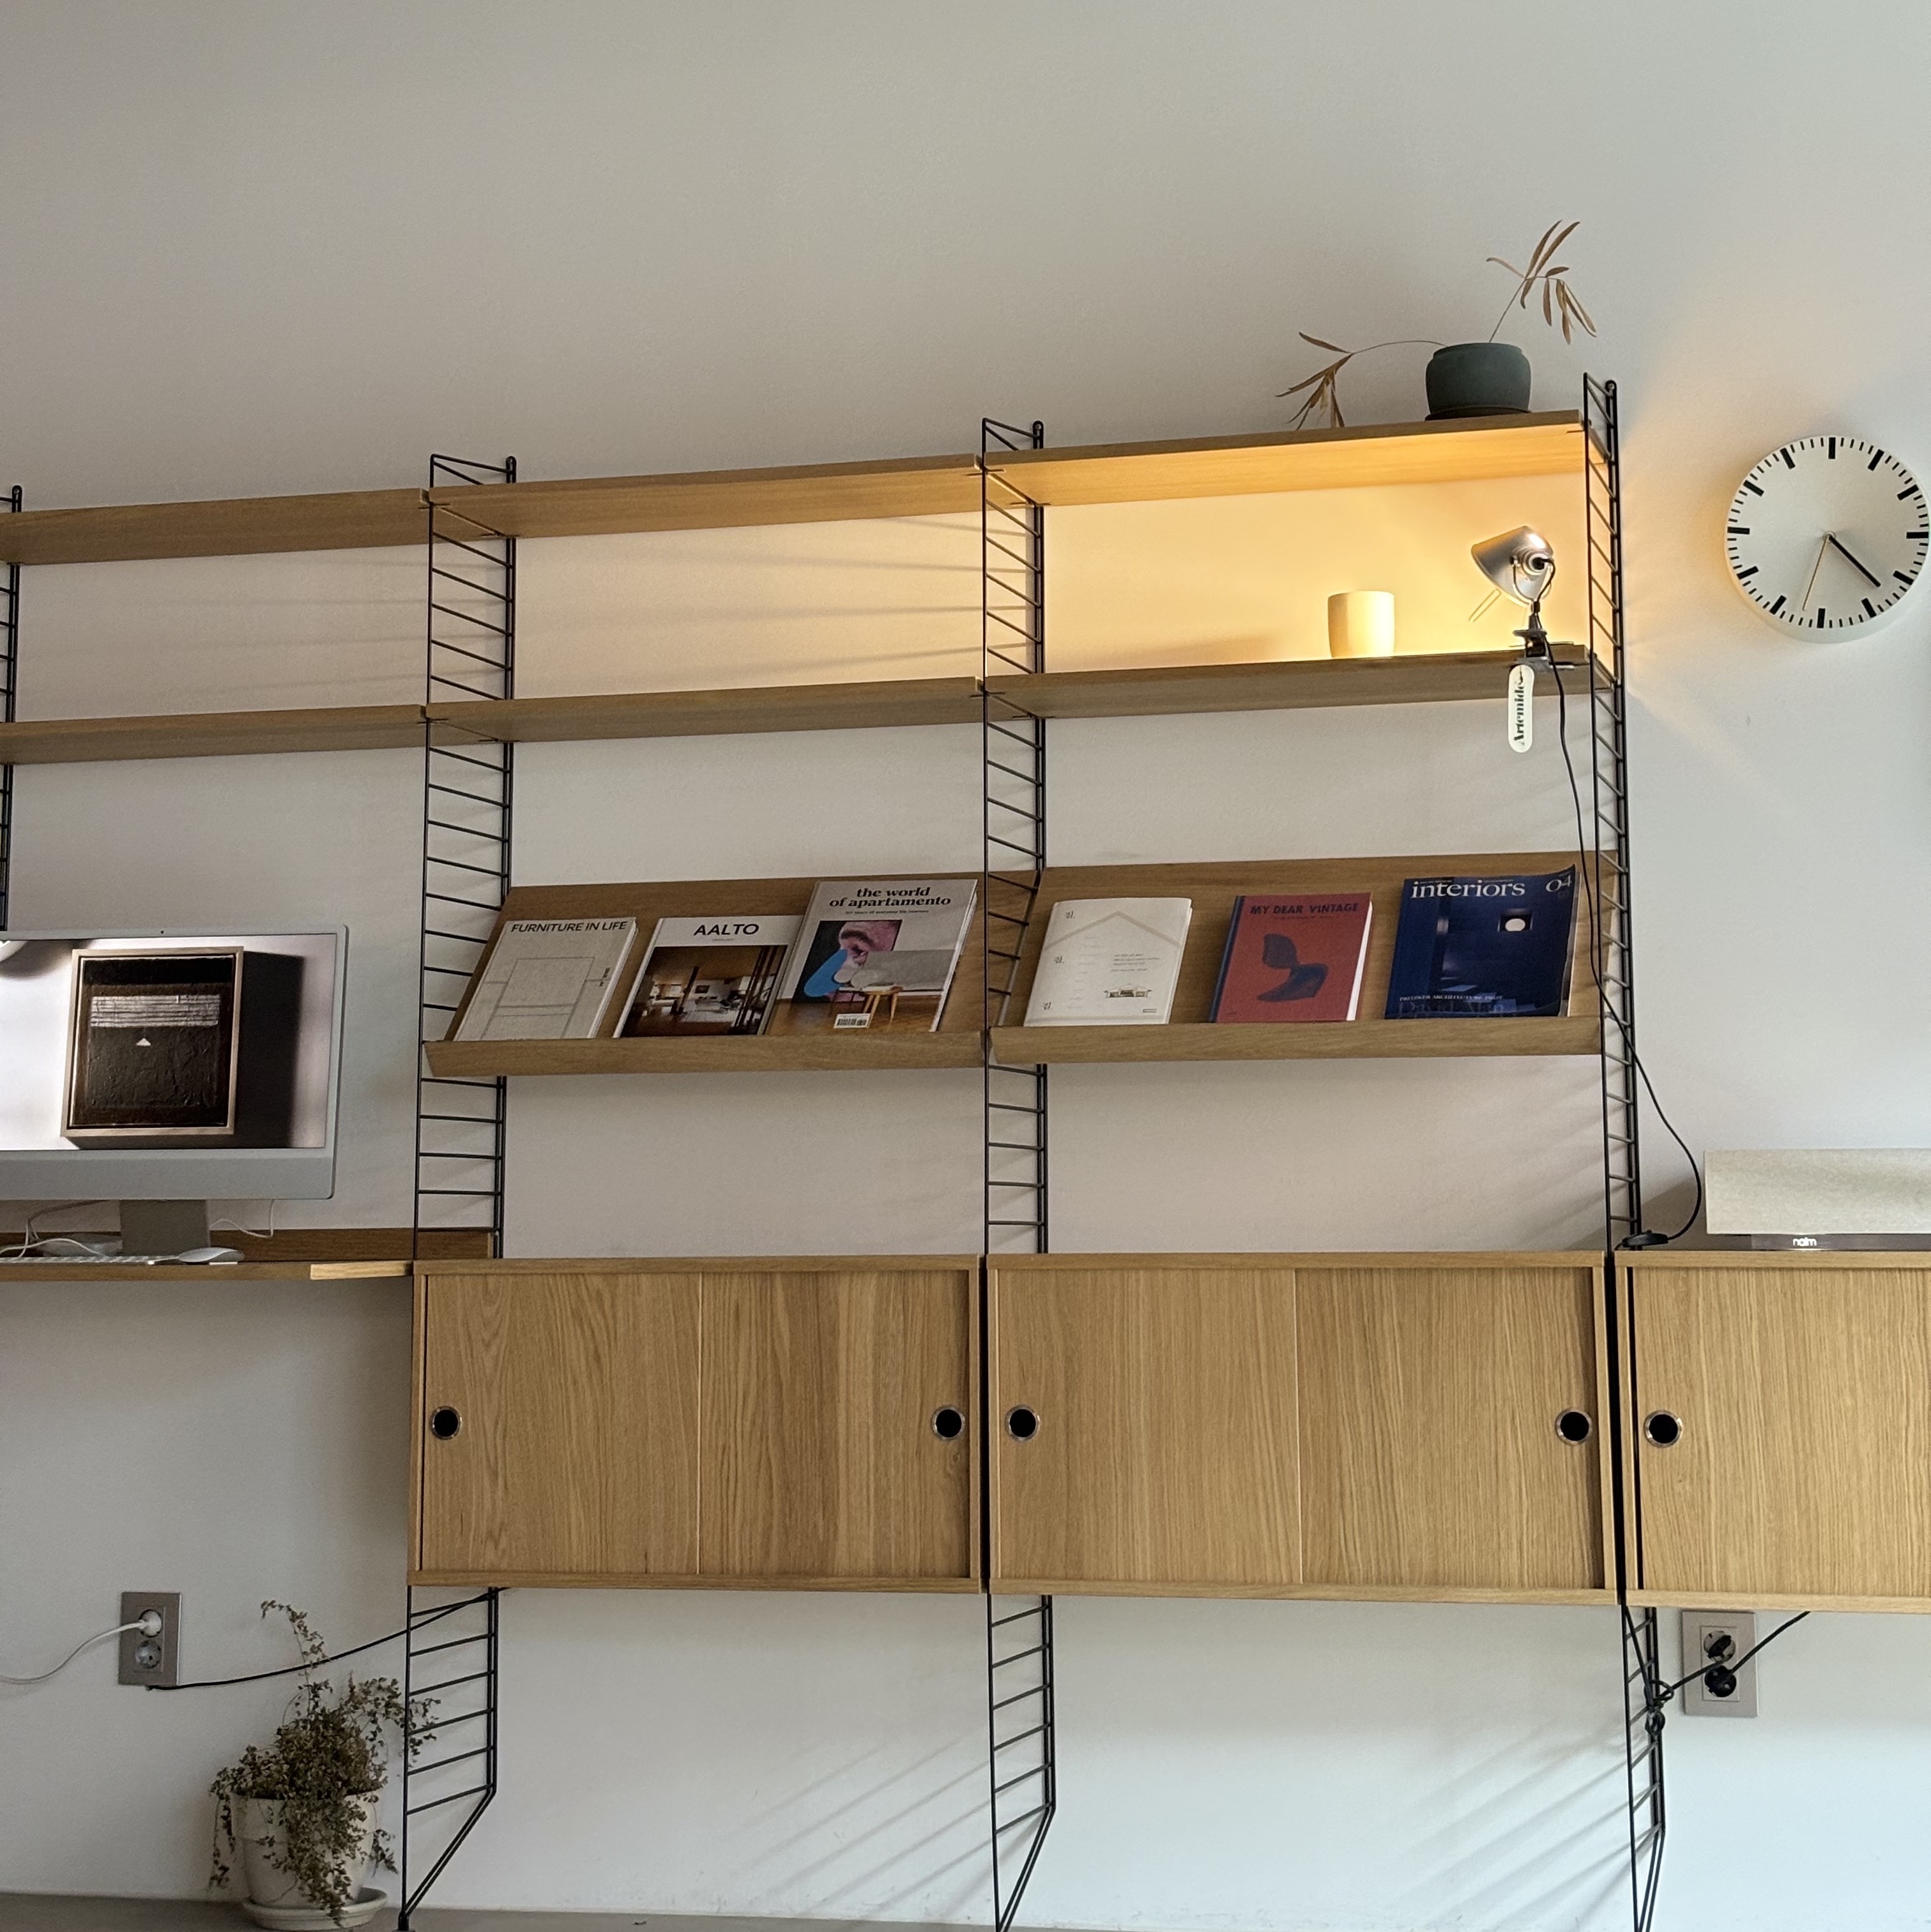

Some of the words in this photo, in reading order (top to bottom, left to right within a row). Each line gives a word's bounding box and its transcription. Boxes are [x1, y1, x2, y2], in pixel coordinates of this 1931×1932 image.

[857, 888, 882, 897] the
[886, 887, 931, 896] world
[1410, 879, 1526, 899] interiors
[1545, 875, 1572, 892] 04
[829, 897, 847, 907] of
[848, 896, 951, 908] apartamento
[1250, 906, 1269, 914] MY
[1273, 905, 1304, 914] DEAR
[1309, 903, 1359, 913] VINTAGE
[511, 922, 584, 932] FURNITURE
[585, 922, 600, 931] IN
[601, 921, 628, 931] LIFE
[694, 924, 759, 936] AALTO
[1792, 1236, 1817, 1247] naim
